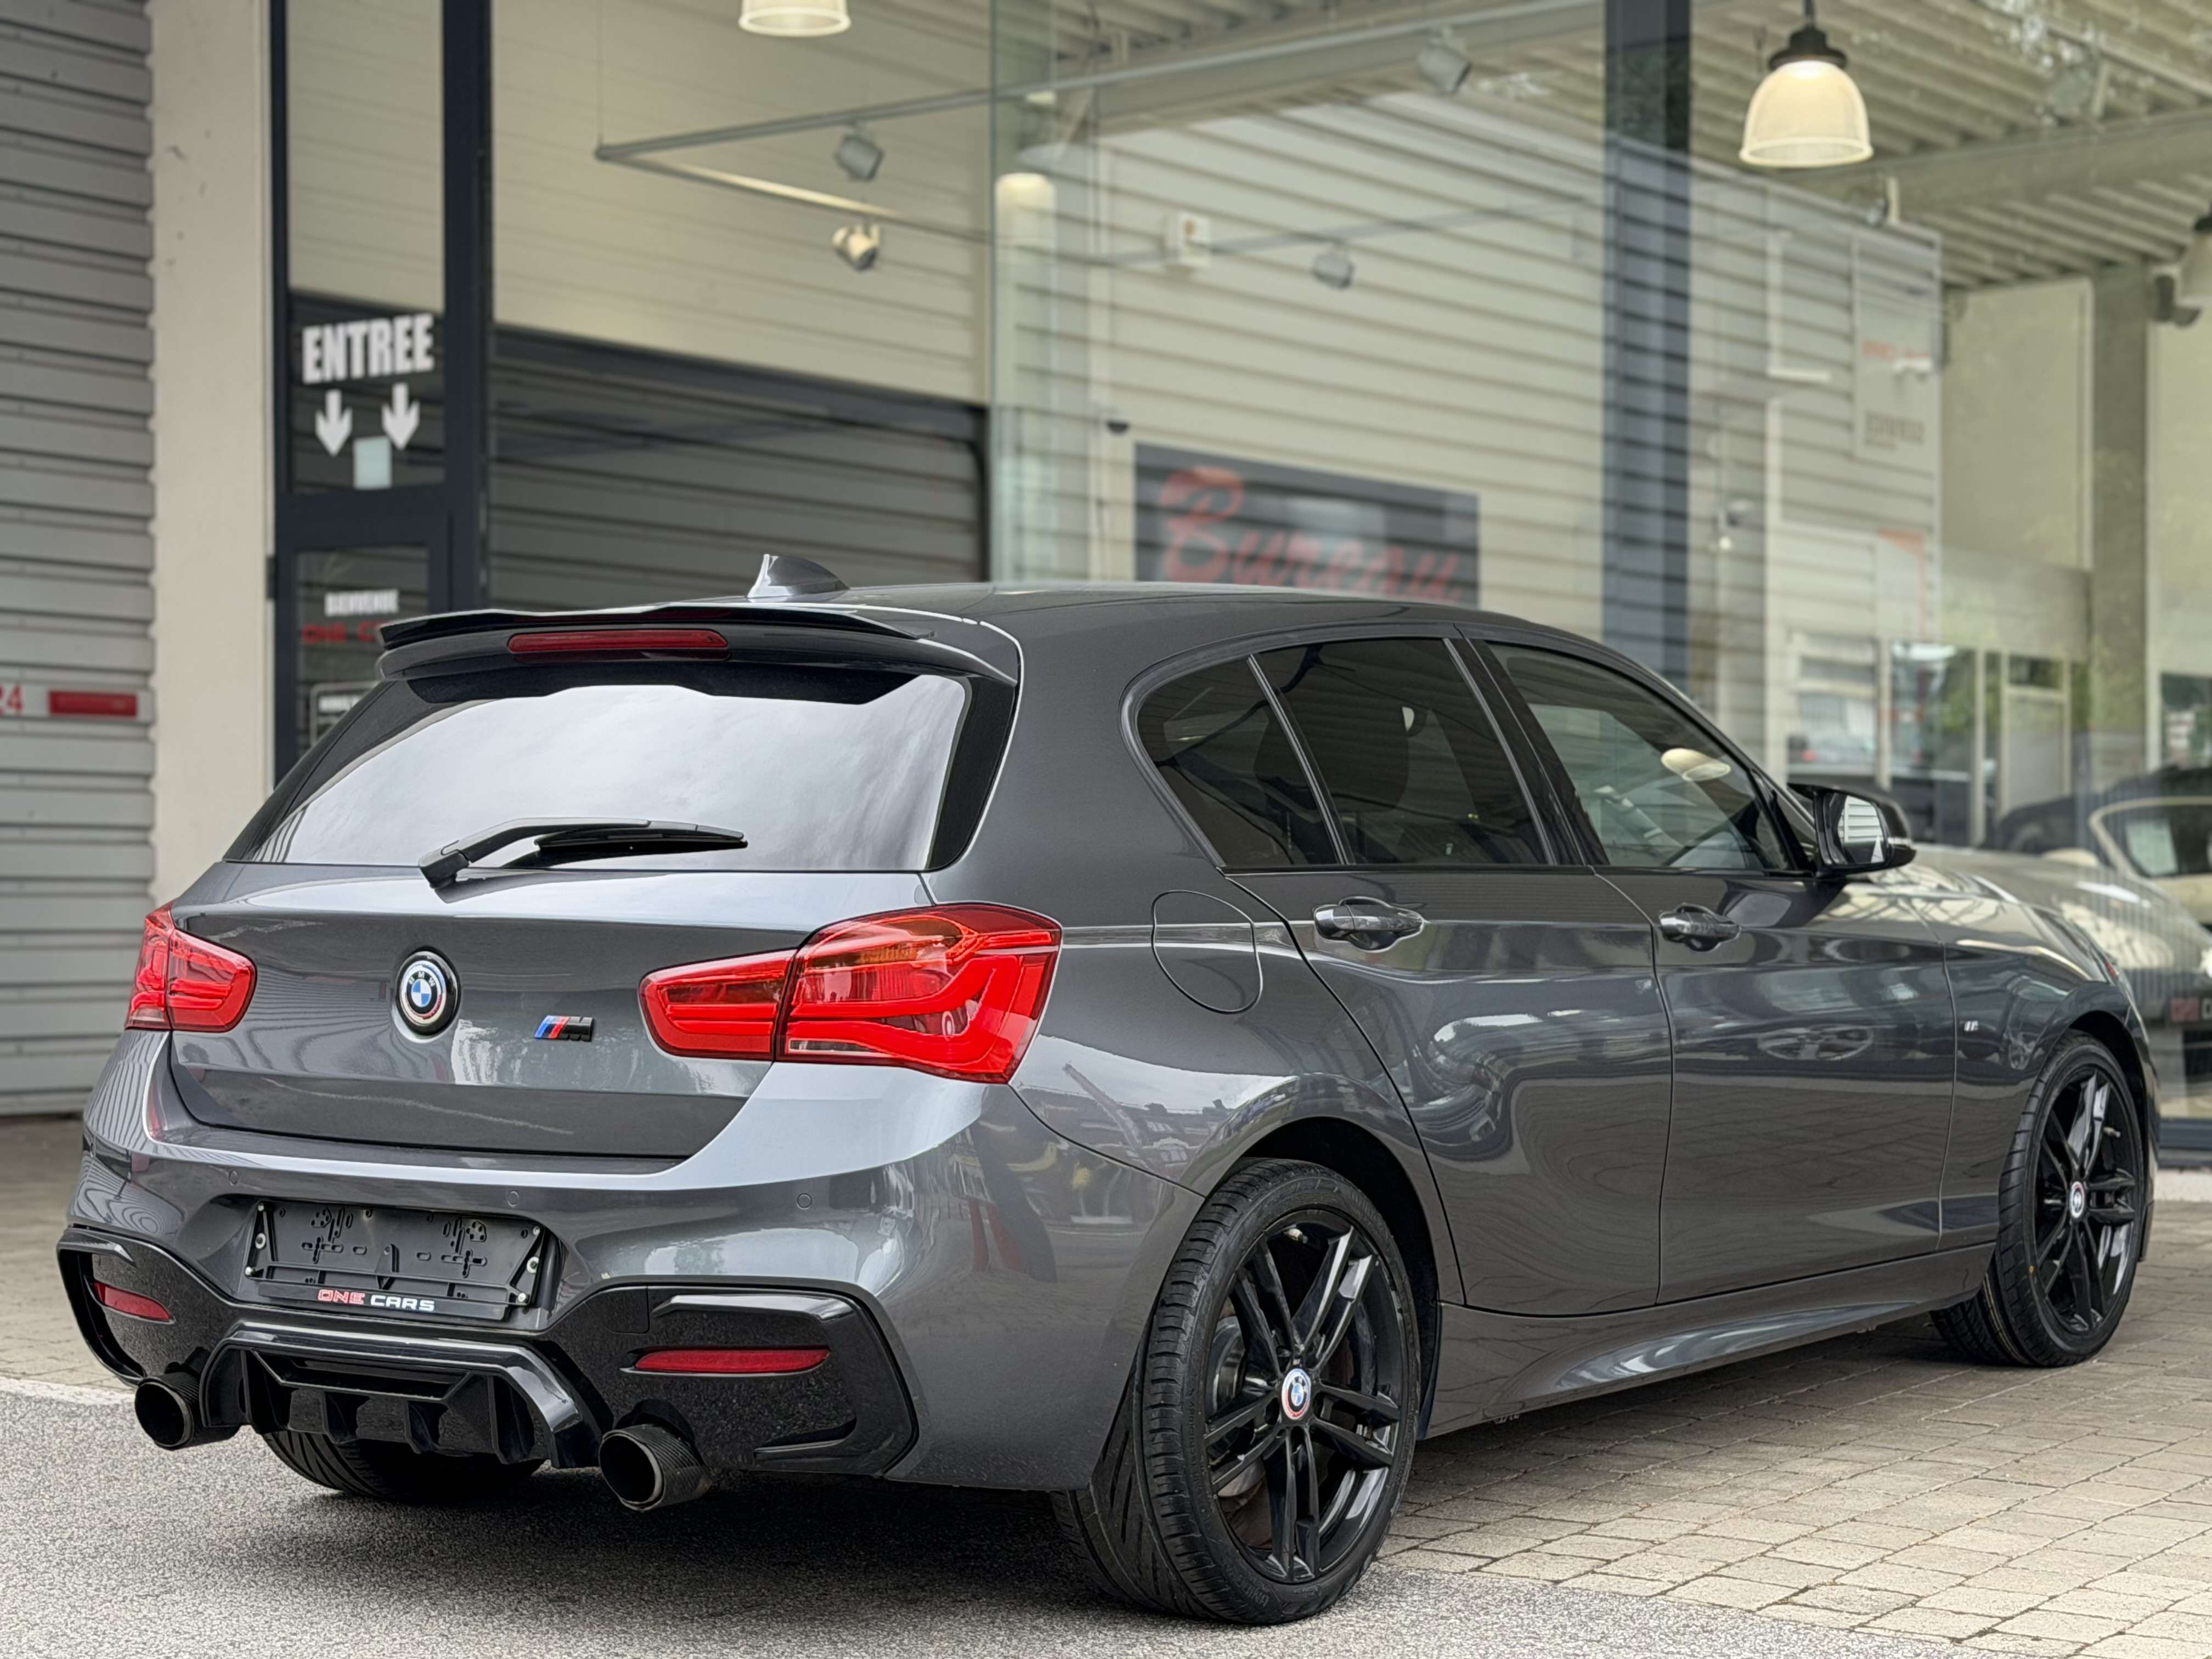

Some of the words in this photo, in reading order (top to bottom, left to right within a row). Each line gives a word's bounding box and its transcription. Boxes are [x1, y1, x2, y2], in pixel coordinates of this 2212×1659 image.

[302, 313, 434, 384] ENTREE
[318, 1289, 365, 1305] ONE
[370, 1295, 435, 1312] CARS
